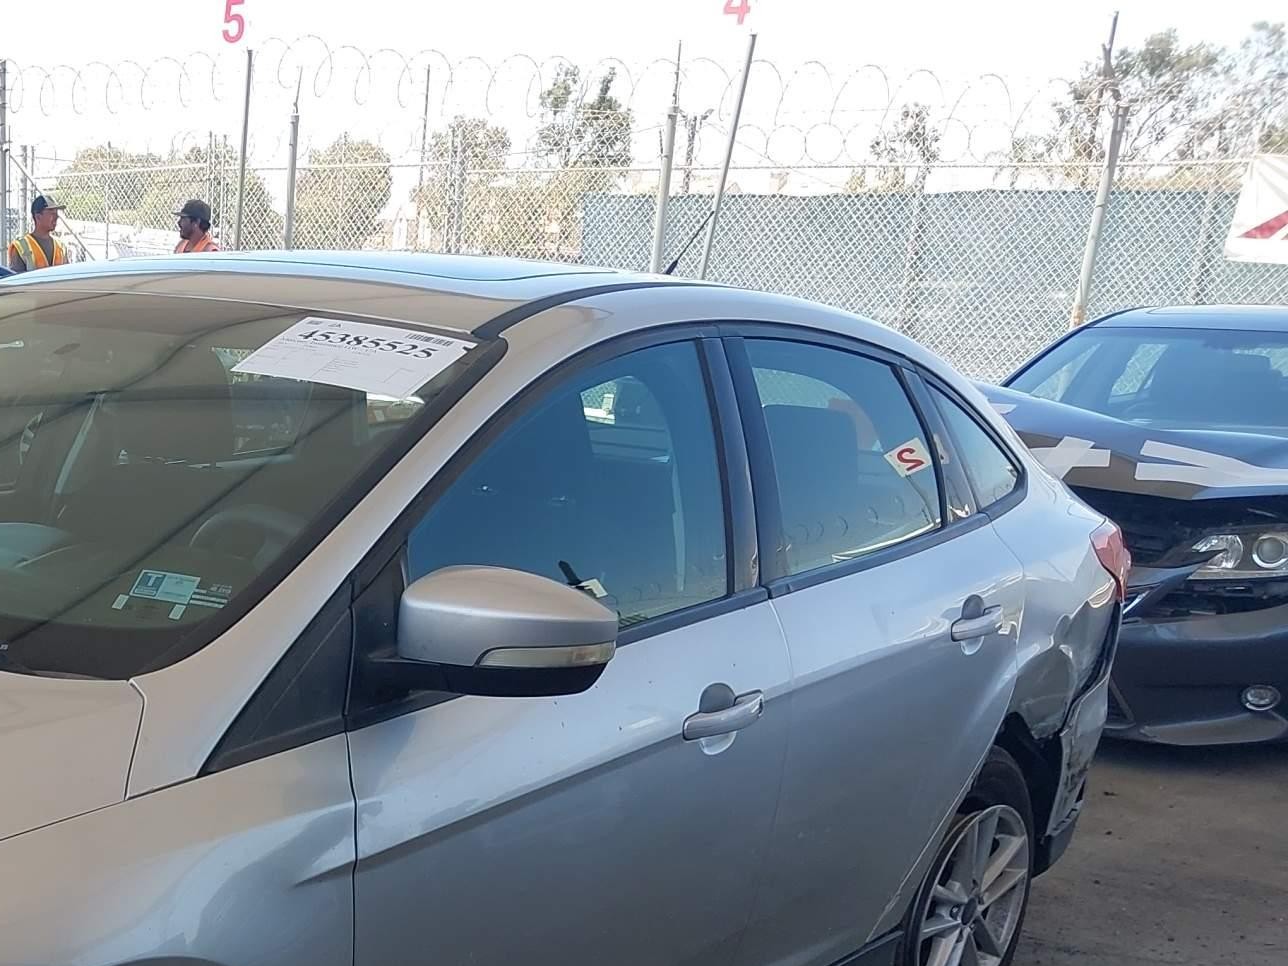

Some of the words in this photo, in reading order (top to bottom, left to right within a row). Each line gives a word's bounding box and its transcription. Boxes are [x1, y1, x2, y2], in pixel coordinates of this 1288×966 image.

[222, 0, 245, 43] 5
[723, 0, 751, 25] 4
[298, 329, 439, 359] 45385525
